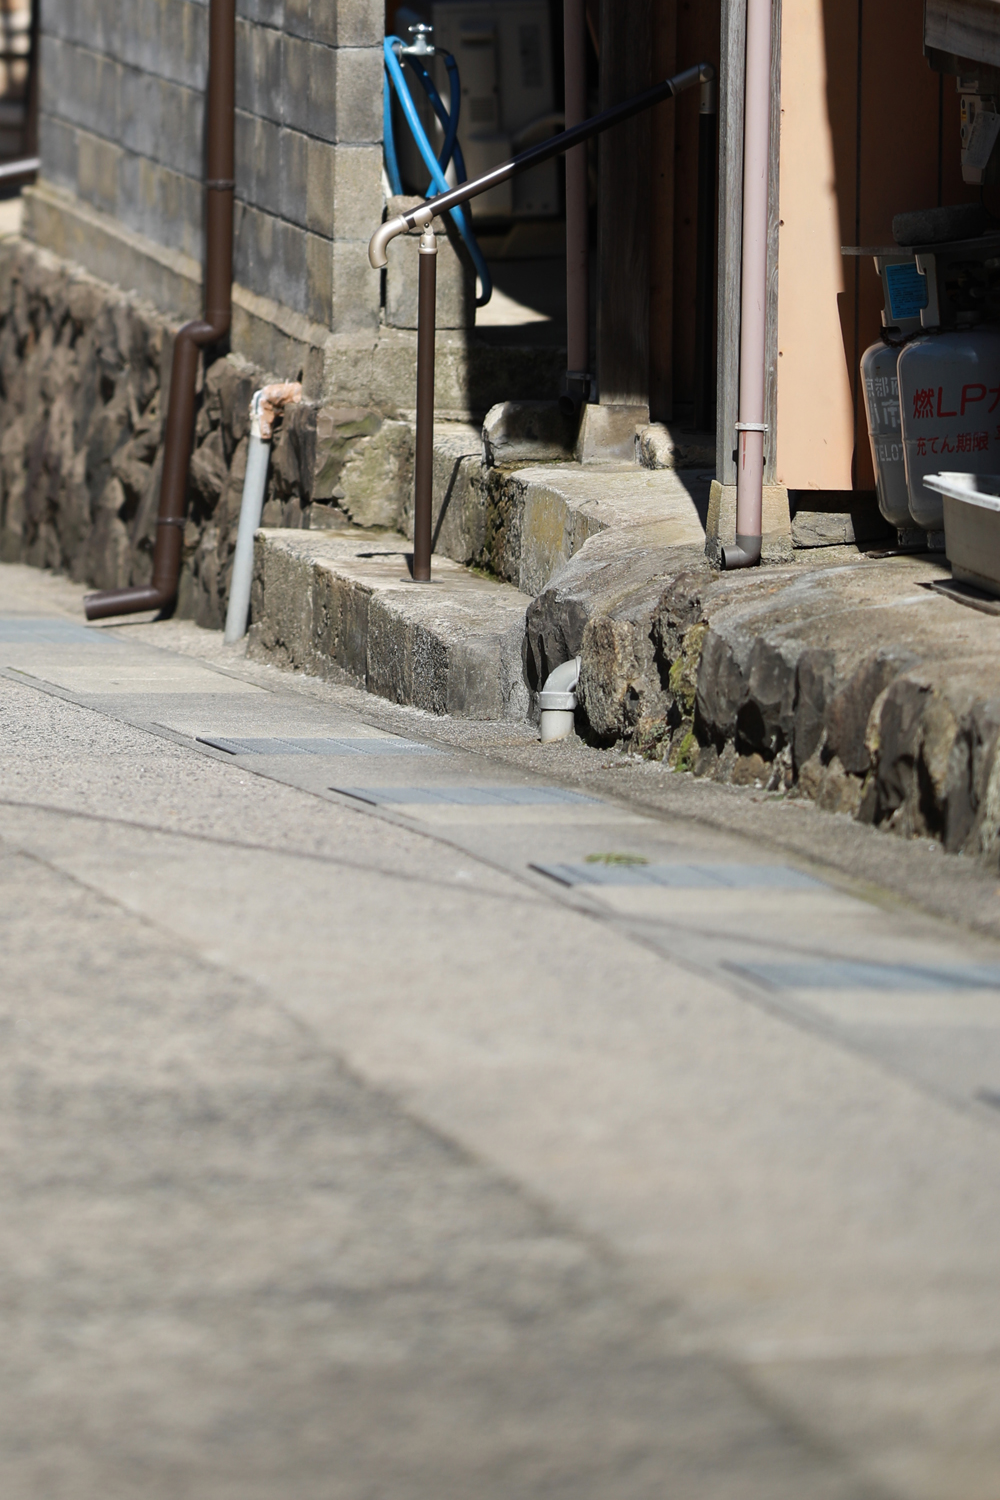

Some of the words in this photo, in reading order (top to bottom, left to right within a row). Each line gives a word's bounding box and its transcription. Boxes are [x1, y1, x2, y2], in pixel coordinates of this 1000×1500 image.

[916, 431, 989, 456] 充てん期限
